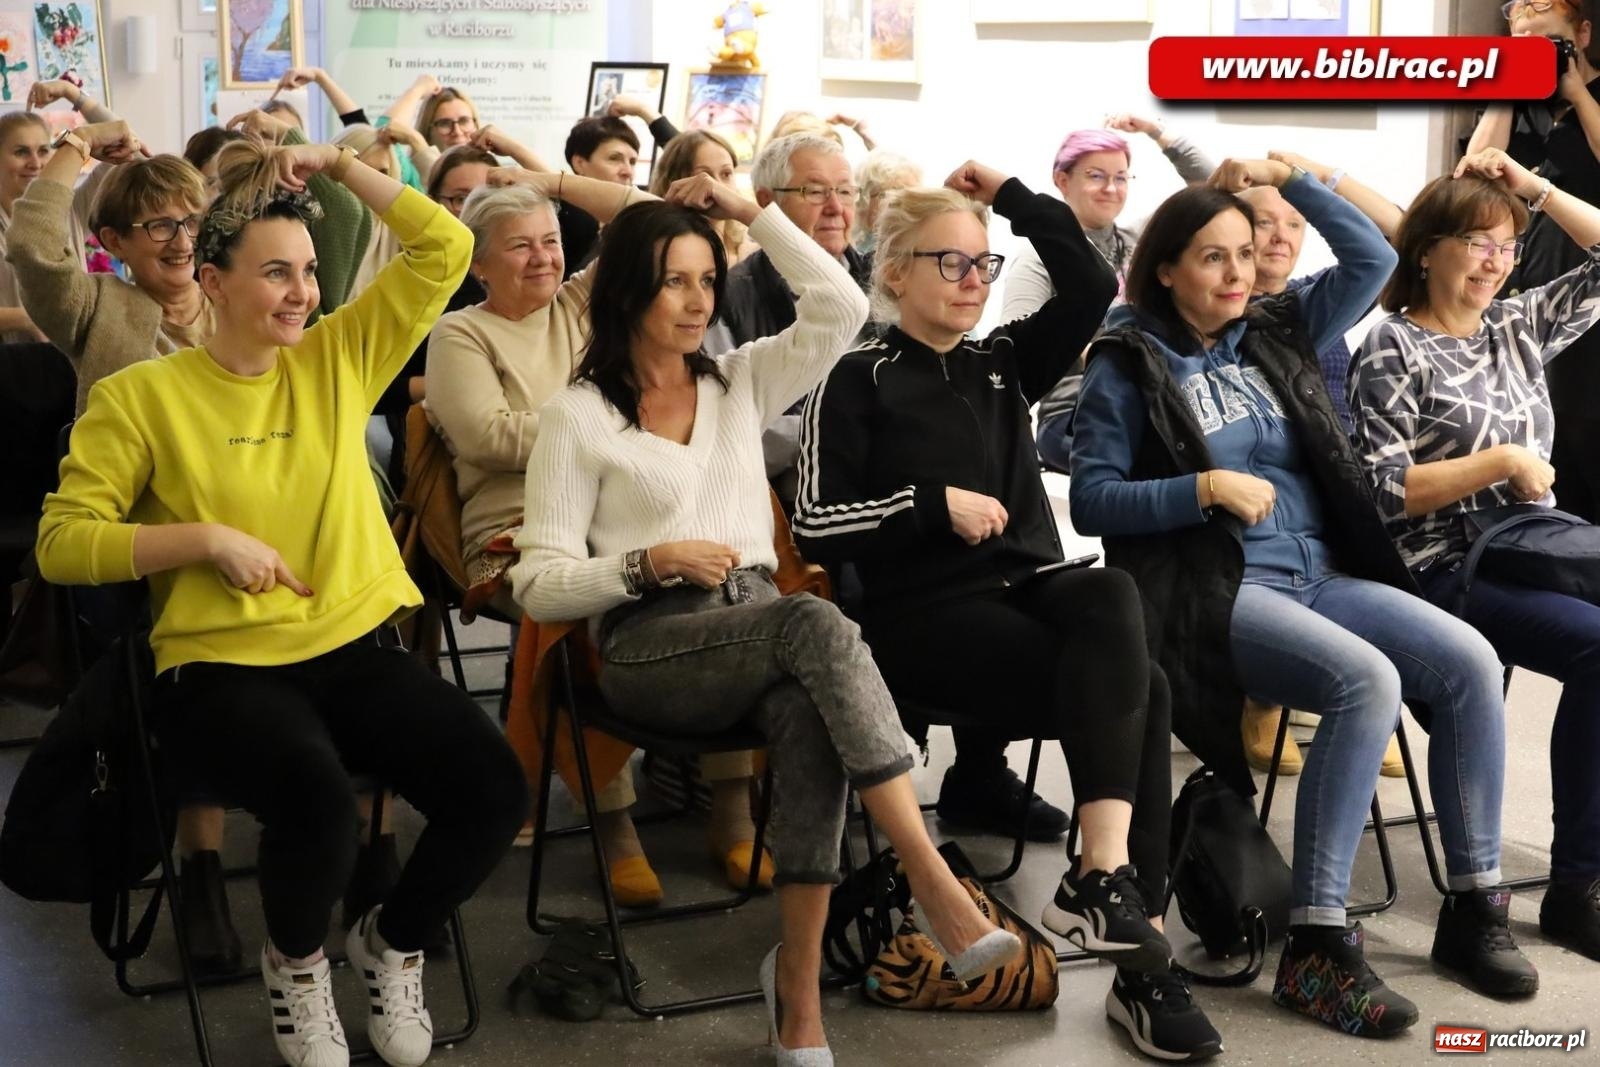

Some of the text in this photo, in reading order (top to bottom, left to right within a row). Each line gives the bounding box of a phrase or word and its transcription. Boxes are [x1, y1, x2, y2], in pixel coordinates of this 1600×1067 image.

[428, 25, 442, 36] w
[387, 57, 402, 68] Tu
[405, 57, 470, 71] mieszkamy
[481, 60, 525, 71] uczymy
[437, 75, 496, 87] Oferujemy:
